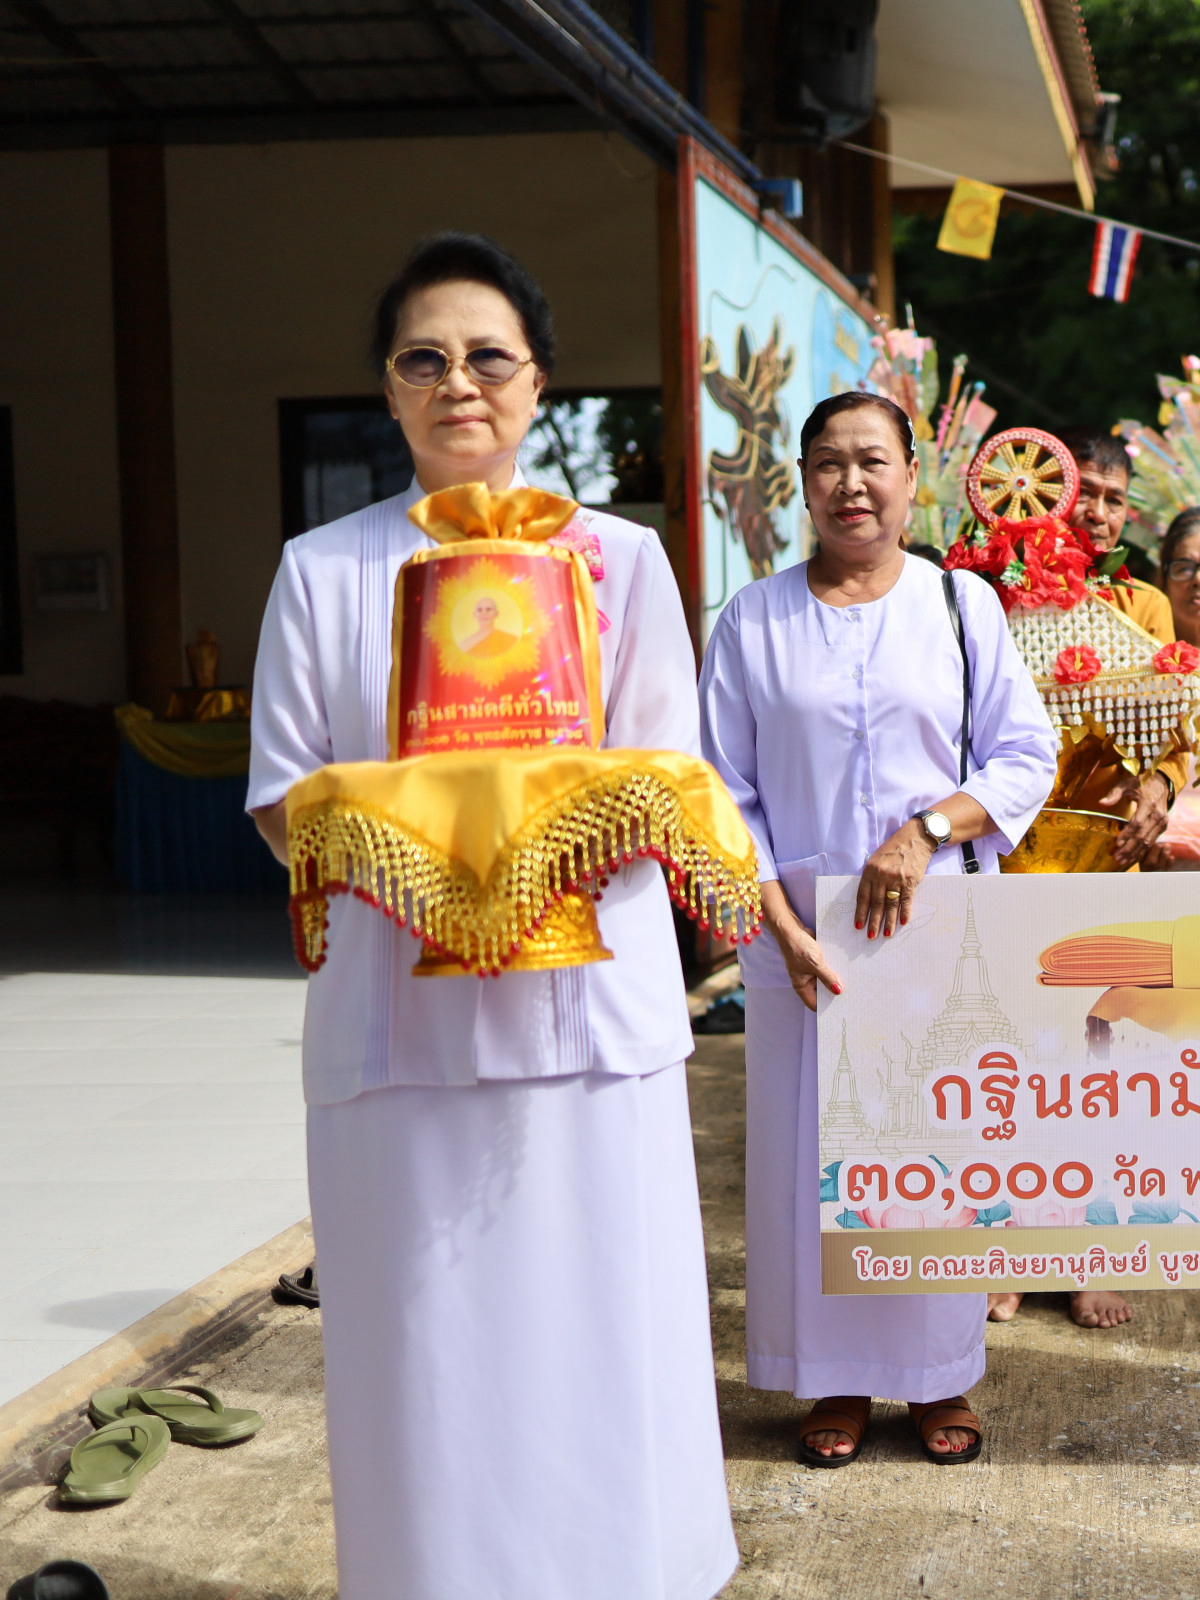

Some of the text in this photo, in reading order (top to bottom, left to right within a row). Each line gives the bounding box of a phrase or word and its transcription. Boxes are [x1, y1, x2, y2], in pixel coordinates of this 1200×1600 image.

[847, 1161, 1093, 1211] ๓๐,๐๐๐
[1113, 1154, 1166, 1198] วัด
[855, 1249, 908, 1277] โดย
[922, 1244, 1147, 1282] คณะศิษยานุศิษย์
